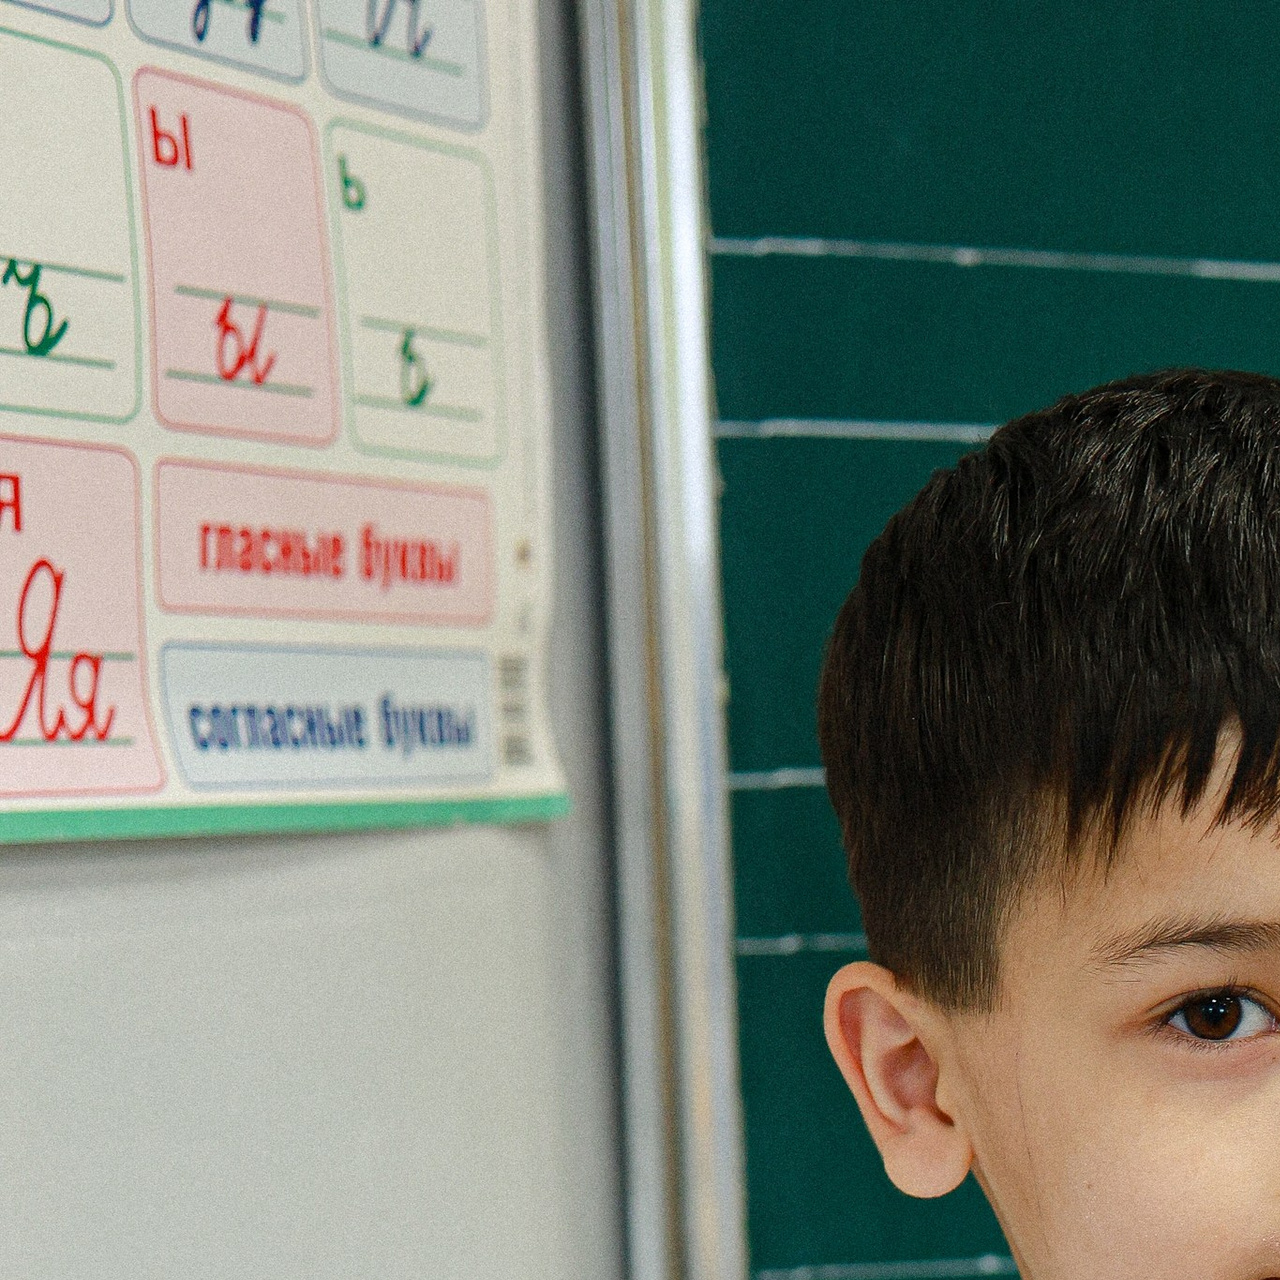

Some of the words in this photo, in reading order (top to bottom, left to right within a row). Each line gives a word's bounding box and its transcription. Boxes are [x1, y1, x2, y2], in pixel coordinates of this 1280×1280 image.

[199, 521, 344, 580] гласные
[360, 521, 462, 591] буквы
[188, 703, 366, 751] согласные
[380, 693, 474, 760] буквы
